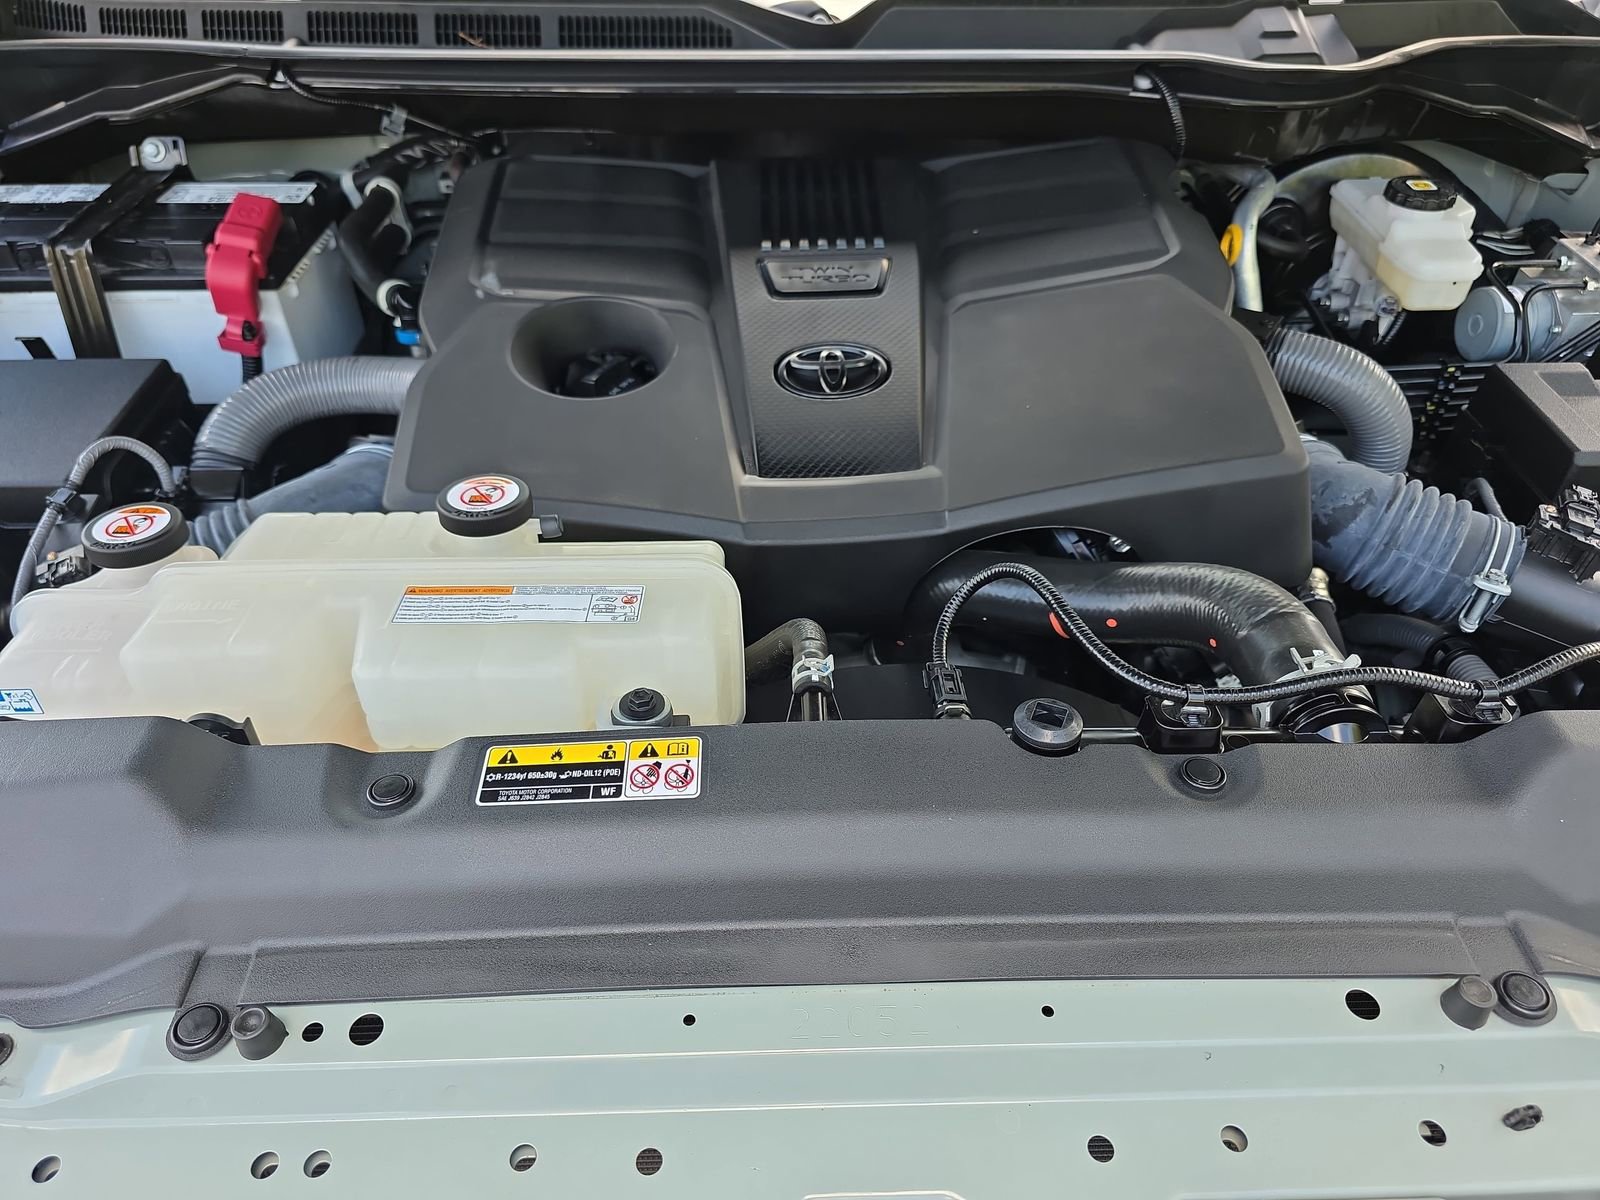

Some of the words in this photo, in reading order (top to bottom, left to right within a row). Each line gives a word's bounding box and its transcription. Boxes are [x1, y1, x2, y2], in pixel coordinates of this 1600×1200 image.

[781, 274, 871, 284] TURBO
[495, 772, 527, 781] R-1234yf
[527, 771, 557, 780] 650±30g
[603, 768, 621, 777] (POE)
[600, 786, 617, 796] WF
